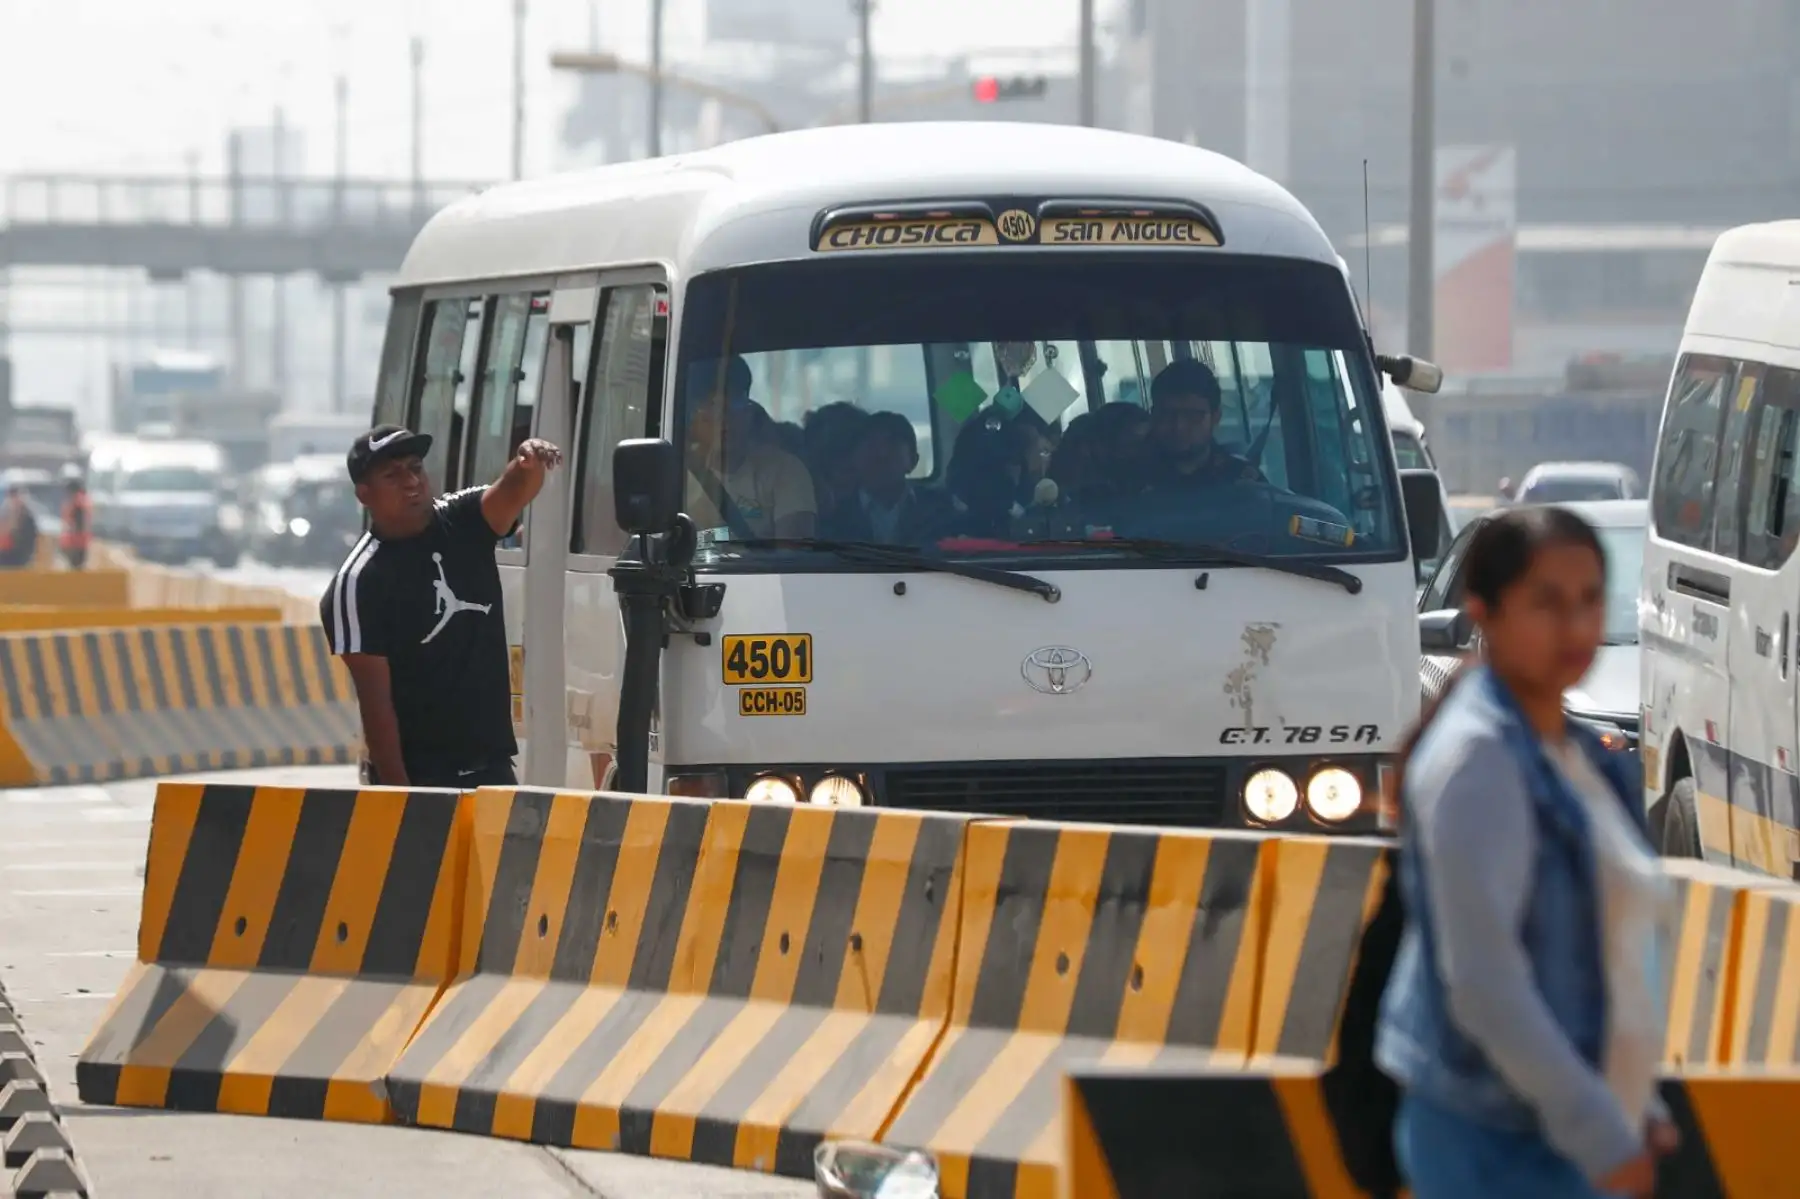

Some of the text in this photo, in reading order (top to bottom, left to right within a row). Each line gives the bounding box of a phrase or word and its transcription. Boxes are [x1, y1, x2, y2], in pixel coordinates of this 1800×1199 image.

[1002, 215, 1033, 240] 4501
[1110, 221, 1202, 242] MIGUEL
[727, 639, 807, 678] 4501
[742, 691, 804, 713] CCH-05
[1283, 726, 1322, 744] 78
